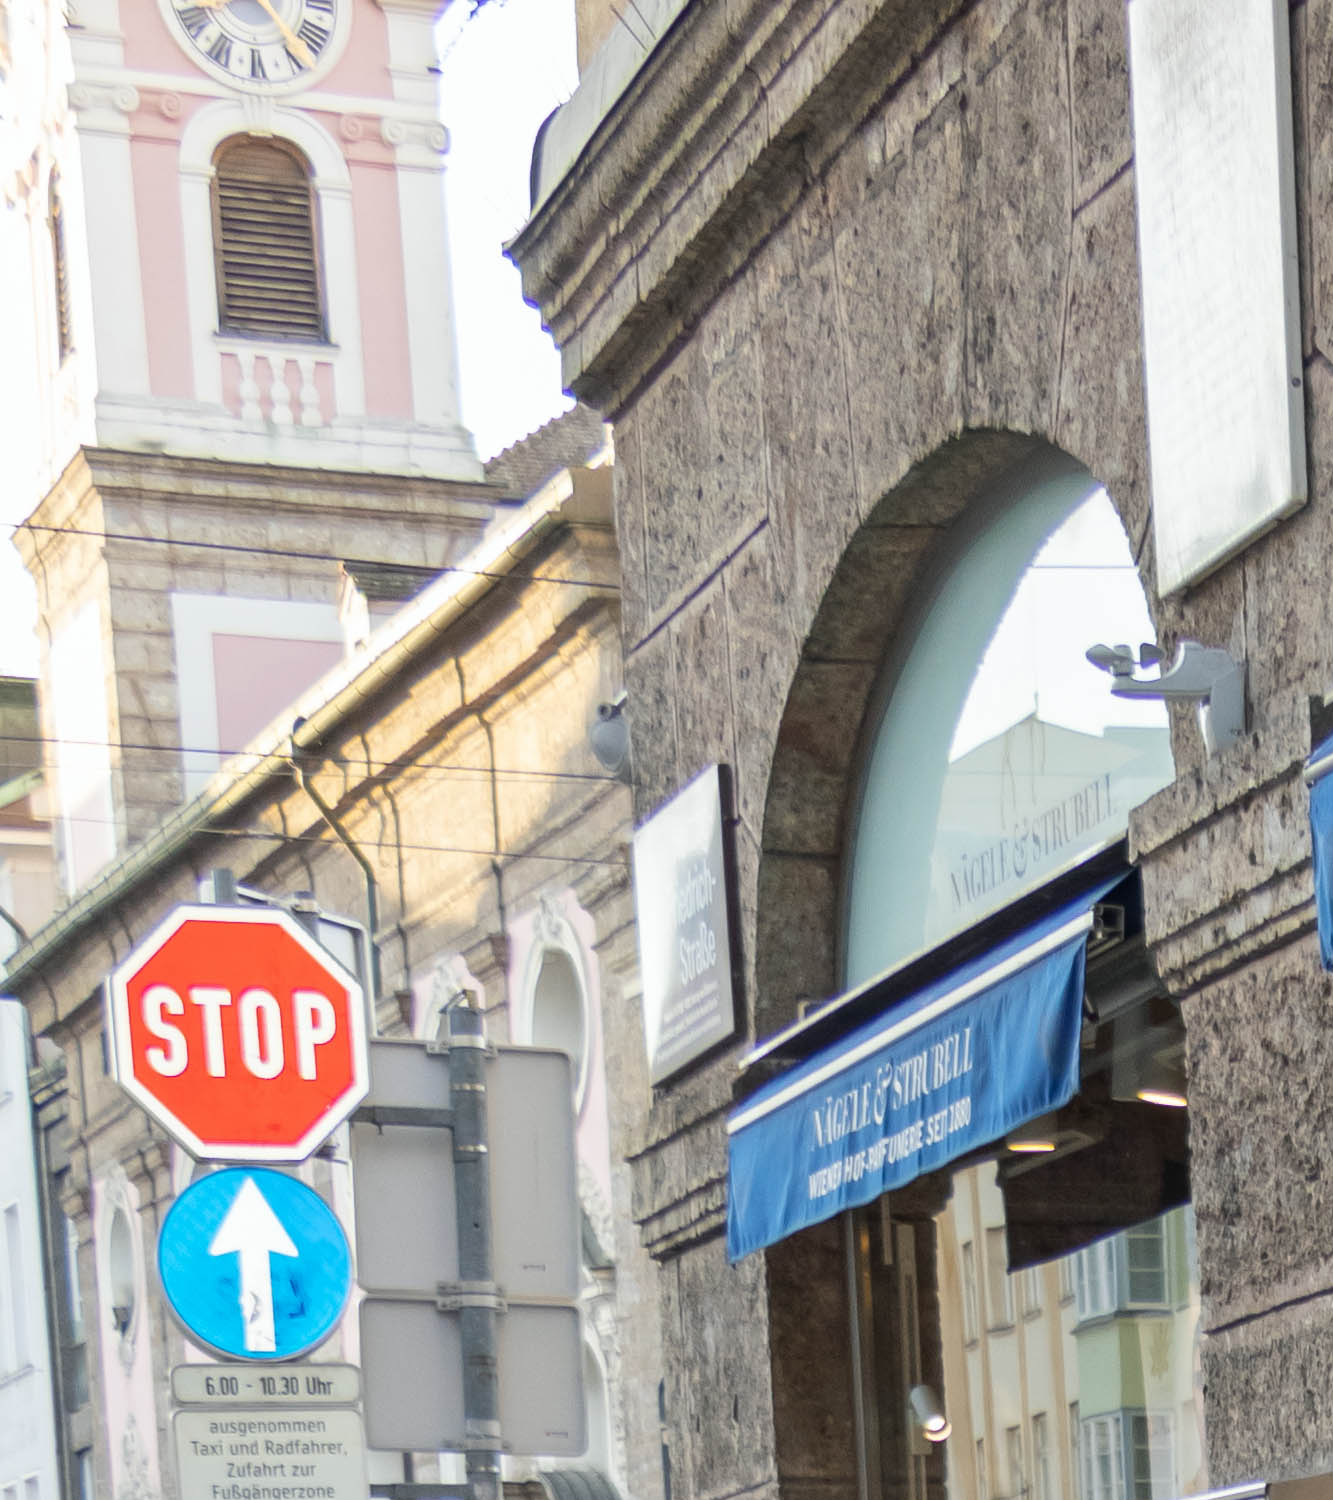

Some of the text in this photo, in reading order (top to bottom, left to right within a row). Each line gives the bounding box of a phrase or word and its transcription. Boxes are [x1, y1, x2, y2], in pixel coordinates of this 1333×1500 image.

[142, 985, 336, 1080] STOP
[811, 1082, 872, 1151] NÄGELE
[893, 1028, 973, 1111] STRUBELL
[205, 1376, 239, 1397] 6.00
[260, 1376, 300, 1397] 10.30
[306, 1376, 334, 1396] Uhr
[209, 1420, 326, 1437] ausgenommen
[190, 1439, 348, 1457] Taxi und Radfahrer,
[226, 1462, 316, 1478] Zufahrt zur
